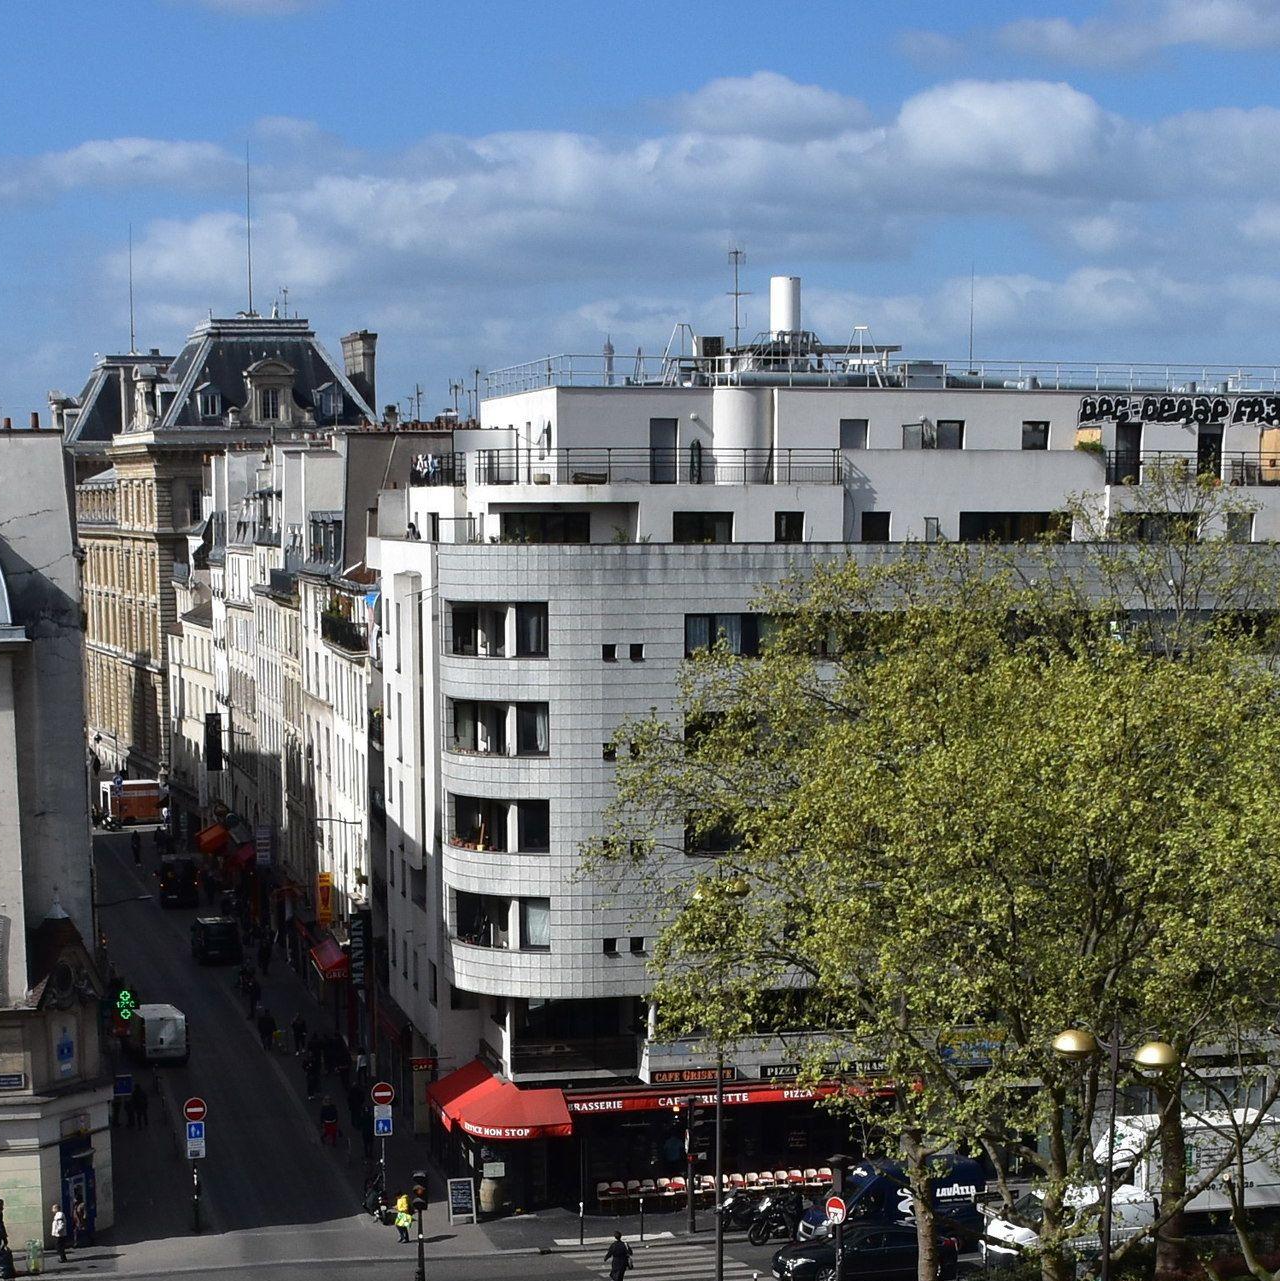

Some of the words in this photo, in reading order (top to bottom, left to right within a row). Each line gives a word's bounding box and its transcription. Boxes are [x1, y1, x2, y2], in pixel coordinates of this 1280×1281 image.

[683, 1069, 732, 1081] GRISETE
[484, 1127, 502, 1136] NON
[504, 1128, 530, 1137] STOP
